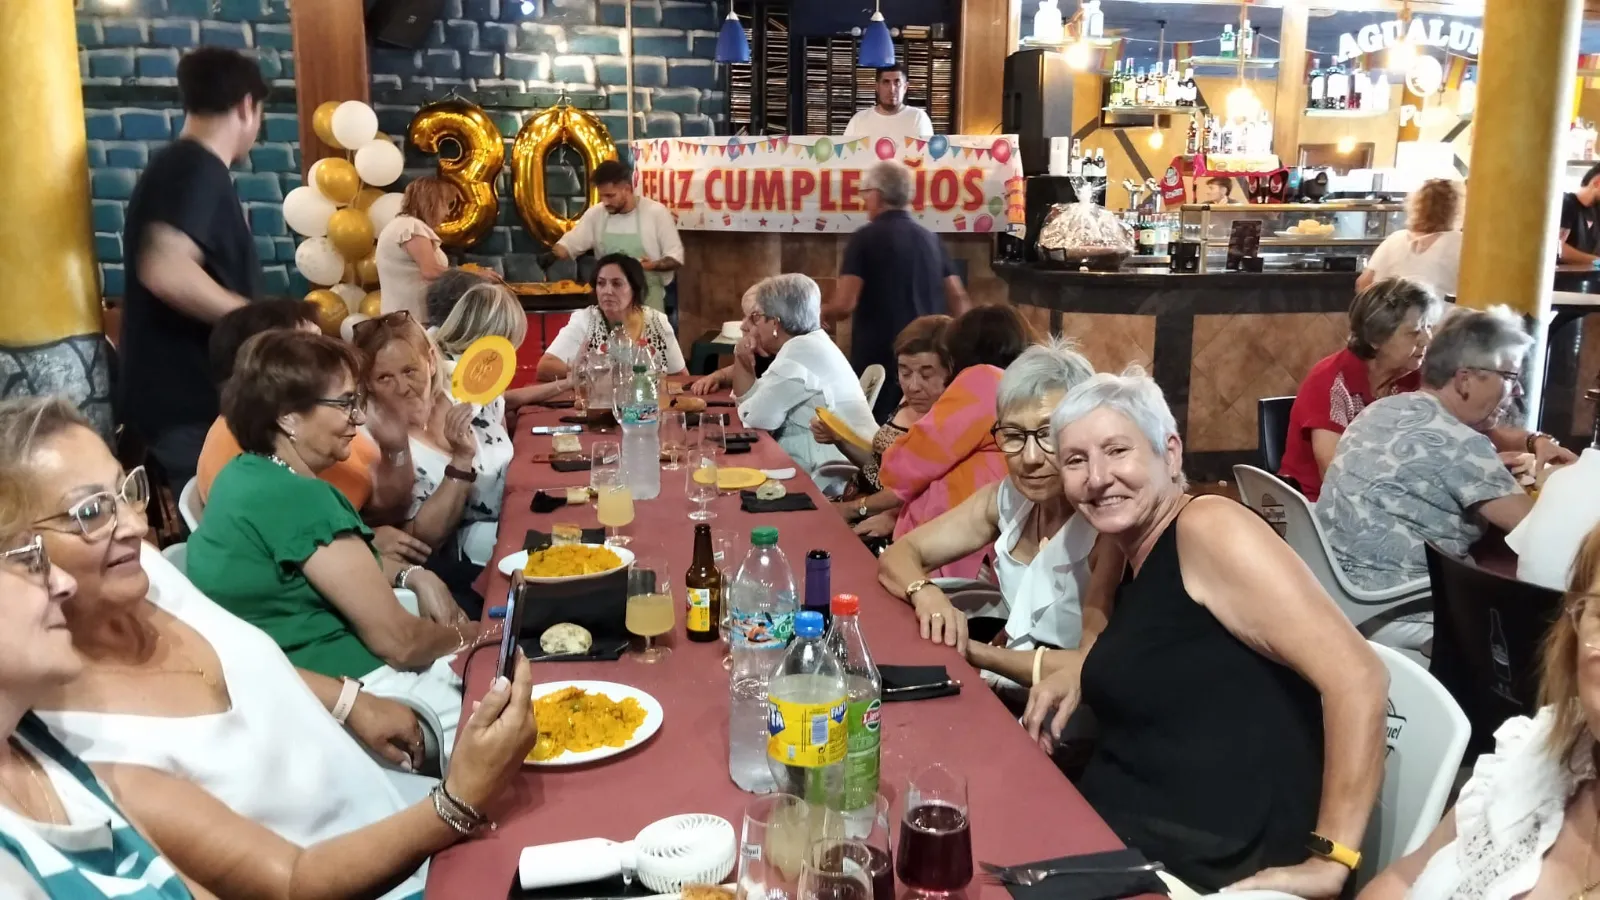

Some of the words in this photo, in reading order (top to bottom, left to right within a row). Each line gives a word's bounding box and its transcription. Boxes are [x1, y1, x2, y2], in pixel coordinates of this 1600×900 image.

[409, 99, 617, 250] 30
[641, 170, 694, 210] FELIZ
[704, 156, 984, 213] CUMPLEÑOS
